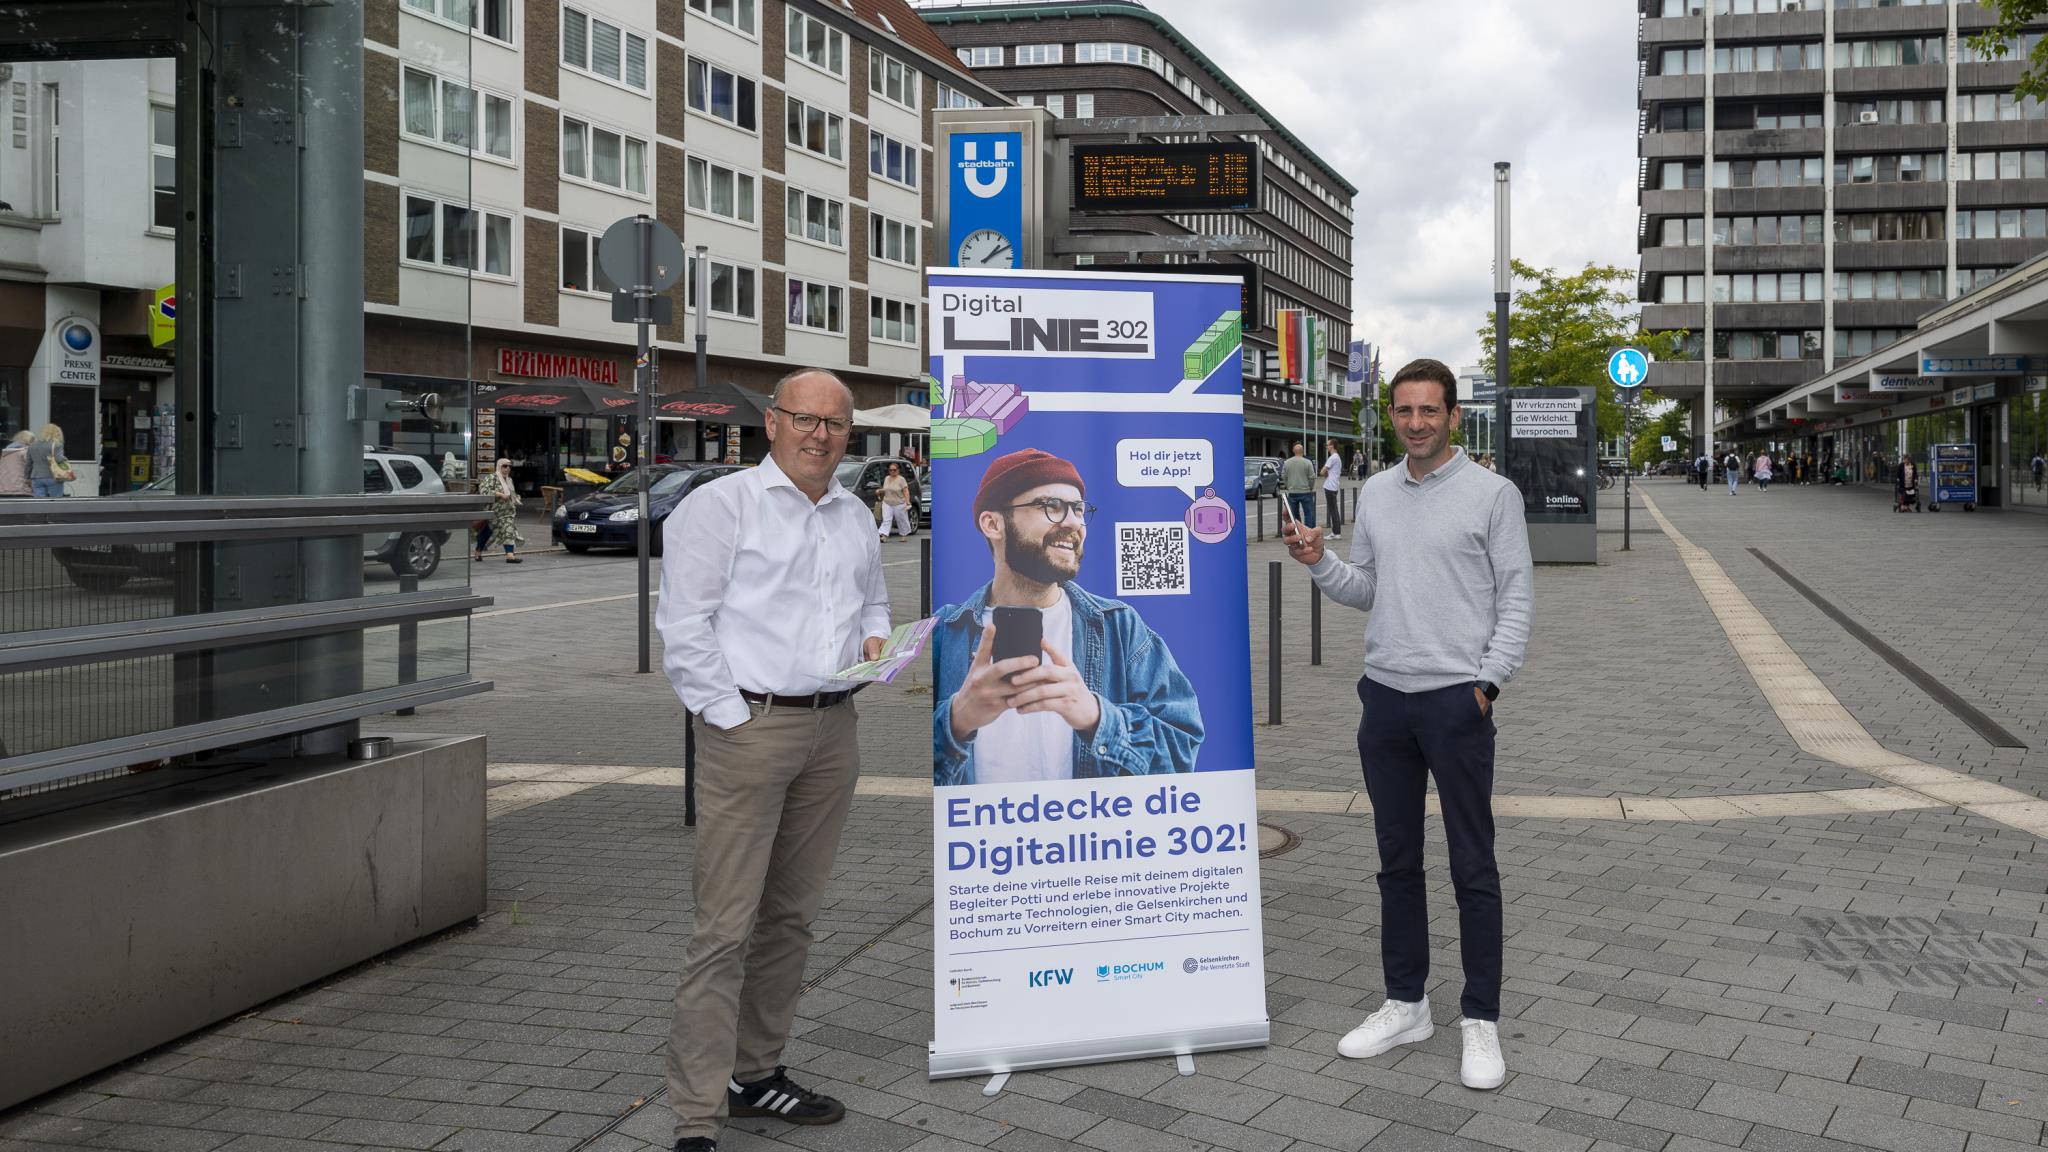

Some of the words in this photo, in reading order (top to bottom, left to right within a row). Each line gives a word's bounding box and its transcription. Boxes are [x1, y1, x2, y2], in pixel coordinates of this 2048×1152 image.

[958, 160, 1014, 168] stadtbahn
[943, 294, 1022, 316] Digital
[944, 316, 1148, 353] LINIE
[1106, 320, 1148, 339] 302
[64, 360, 94, 370] PRESSE
[106, 355, 167, 368] STEGEMANN
[60, 370, 96, 380] CENTER
[1881, 376, 1935, 386] dentwork
[1130, 451, 1150, 461] Hol
[1154, 450, 1170, 461] dir
[1173, 451, 1202, 462] jetzt
[1141, 466, 1159, 476] die
[1162, 466, 1191, 477] App!
[948, 790, 1132, 828] Entdecke
[1144, 785, 1200, 815] die
[948, 830, 1156, 876] Digitallinie
[1167, 822, 1247, 856] 302!
[950, 884, 989, 896] Starte
[993, 882, 1028, 892] deine
[1031, 877, 1081, 889] virtuelle
[1085, 875, 1118, 886] Reise
[1122, 872, 1141, 883] mit
[1144, 870, 1189, 881] deinem
[1192, 866, 1243, 879] digitalen
[950, 898, 1008, 911] Begleiter
[1011, 894, 1042, 906] Potti
[1046, 892, 1069, 903] und
[1072, 889, 1111, 900] erlebe
[1114, 883, 1176, 898] innovative
[1180, 881, 1230, 893] Projekte
[950, 914, 974, 925] und
[978, 912, 1022, 923] smarte
[1026, 904, 1112, 919] Technologien,
[1115, 902, 1133, 912] die
[1137, 894, 1222, 910] Gelsenkirchen
[1226, 893, 1248, 903] und
[950, 927, 1003, 940] Bochum
[1007, 927, 1021, 936] zu
[1025, 921, 1087, 933] Vorreitern
[1091, 918, 1122, 928] einer
[1124, 914, 1162, 926] Smart
[1165, 912, 1189, 923] City
[1193, 908, 1243, 920] machen.
[1200, 954, 1240, 964] Gelsenkirchen
[1029, 968, 1073, 987] KFW
[1114, 962, 1164, 974] BOCHUM
